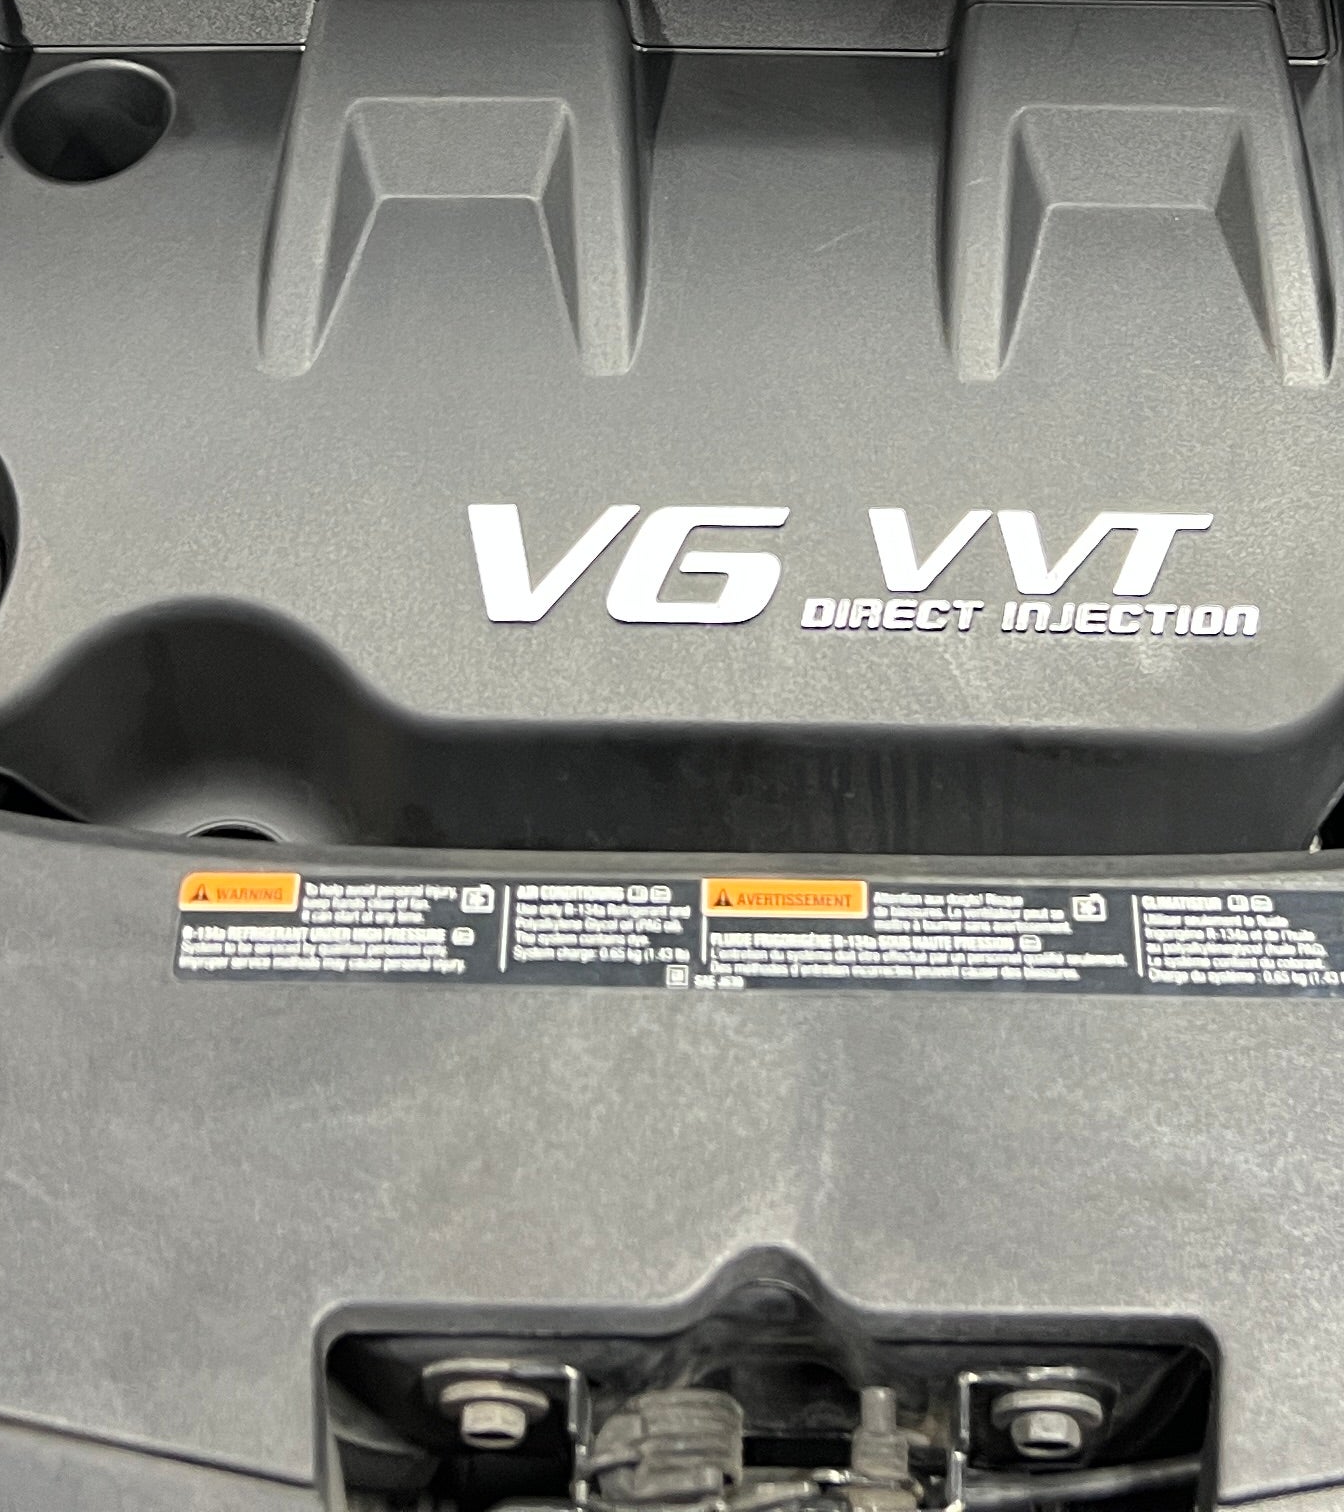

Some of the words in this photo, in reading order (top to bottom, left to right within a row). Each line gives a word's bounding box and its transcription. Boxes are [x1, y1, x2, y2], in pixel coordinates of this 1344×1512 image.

[467, 503, 791, 624] V6
[867, 507, 1215, 597] VVT
[800, 597, 985, 633] DIRECT
[1001, 597, 1261, 637] INJECTION
[216, 887, 284, 901] WARNING
[736, 892, 852, 907] AVERTISSEMENT
